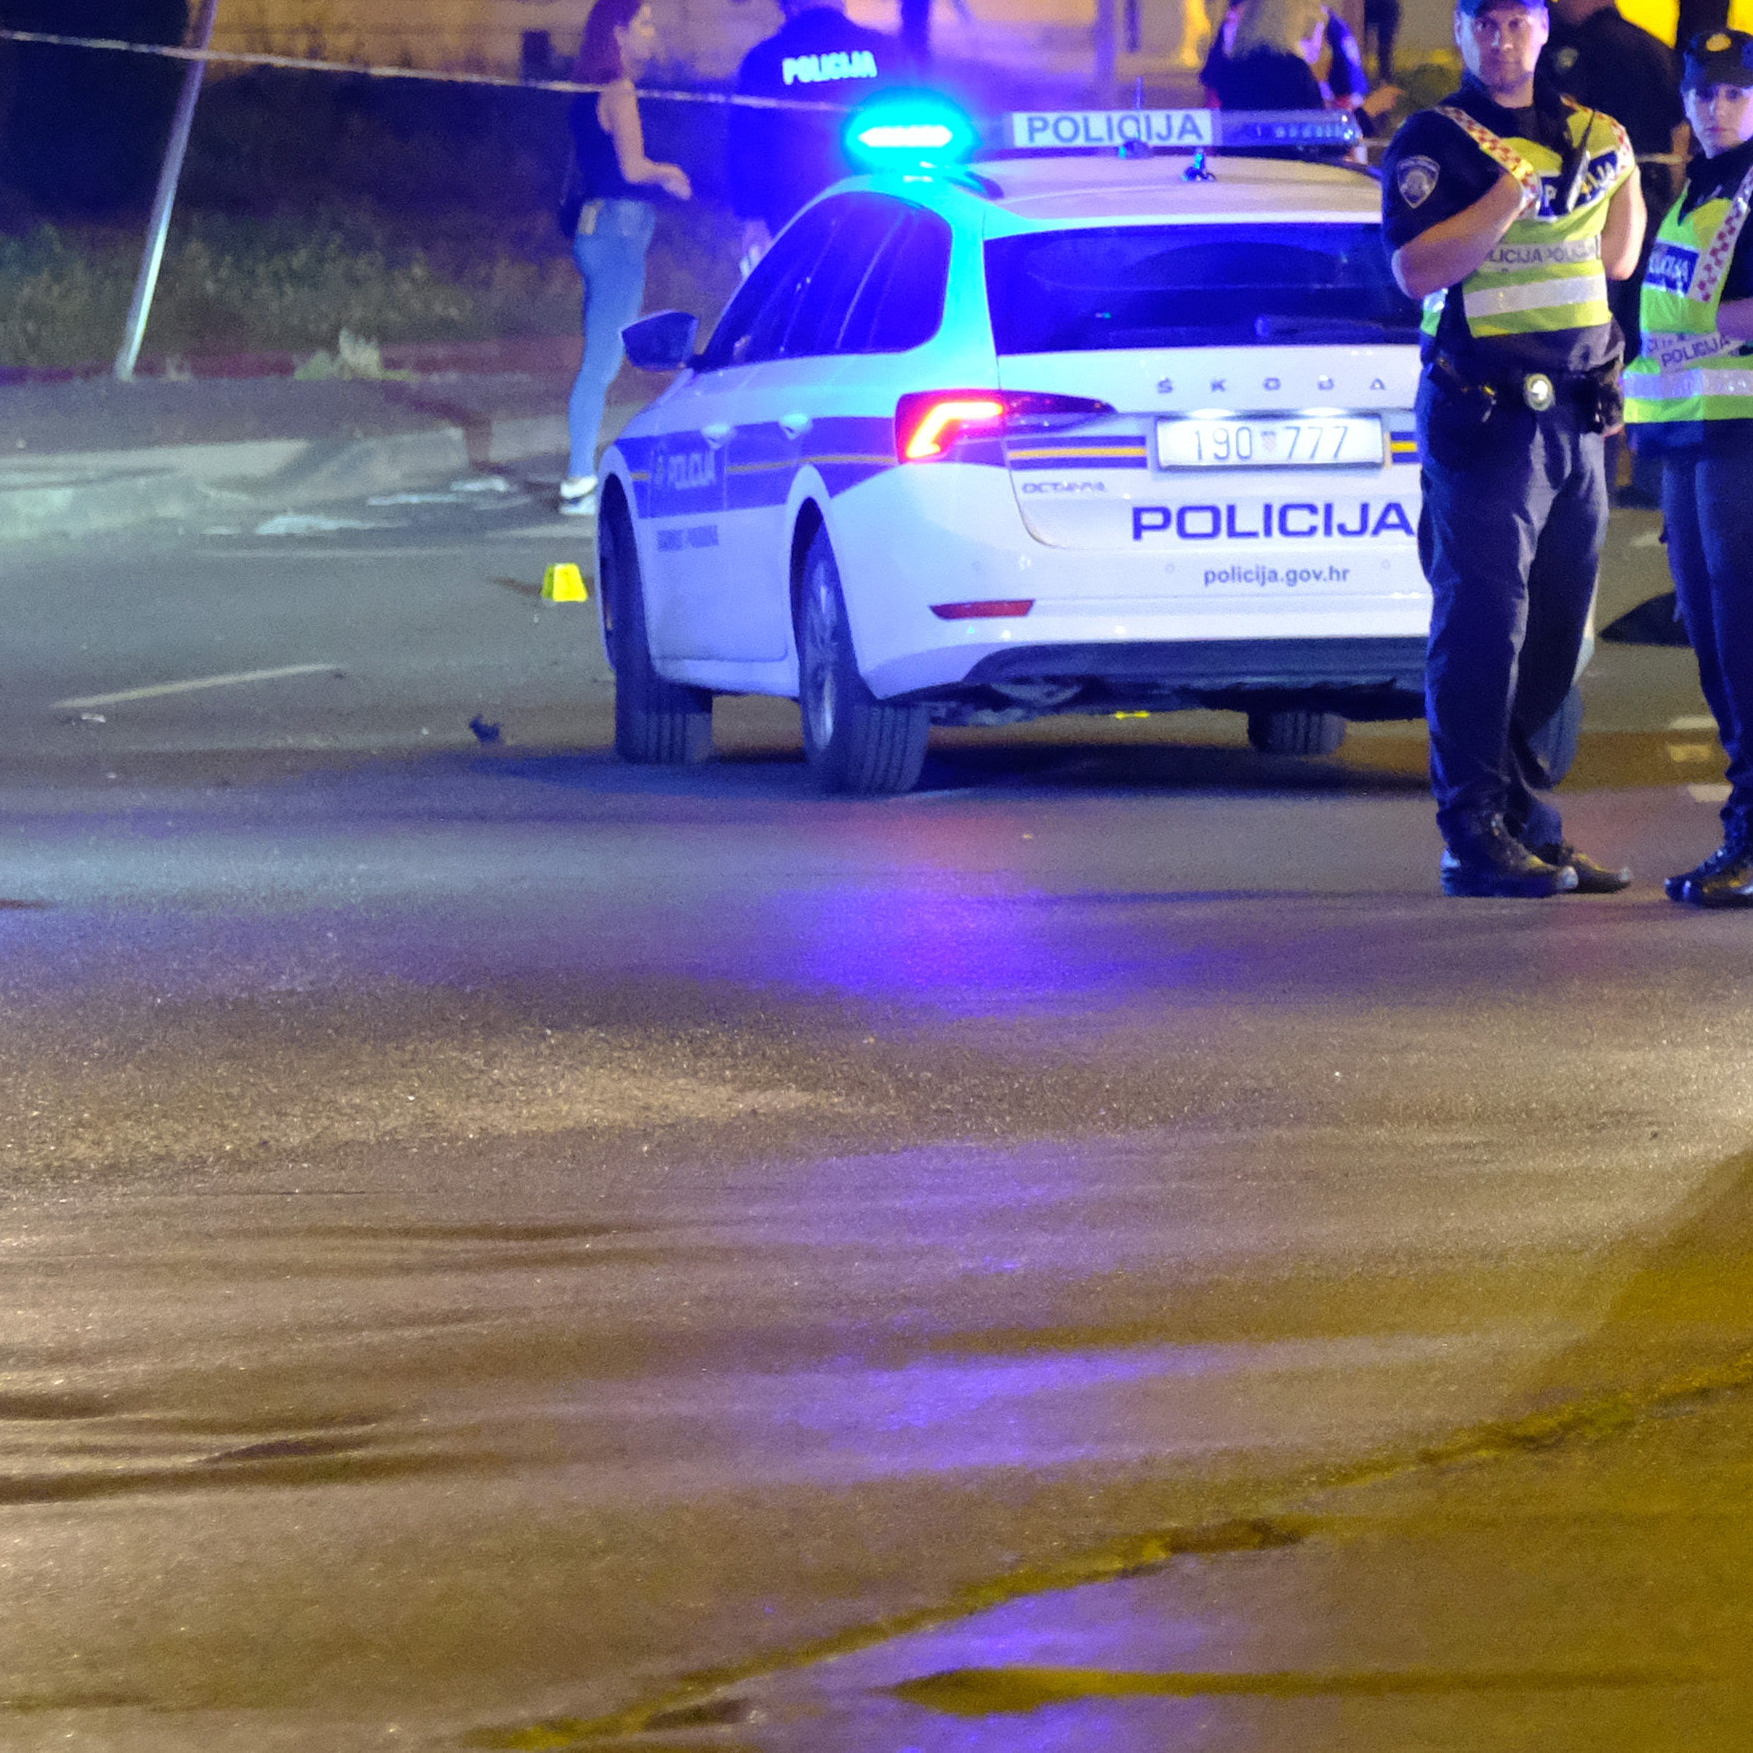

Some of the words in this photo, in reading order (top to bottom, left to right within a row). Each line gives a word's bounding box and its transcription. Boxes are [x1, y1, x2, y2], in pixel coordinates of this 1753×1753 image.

[1027, 113, 1204, 144] POLICIJA
[1489, 247, 1543, 265] LICIJA
[1195, 428, 1253, 461] 190
[1284, 426, 1349, 460] 777
[1132, 502, 1415, 541] POLICIJA
[1204, 564, 1351, 587] policija.gov.hr
